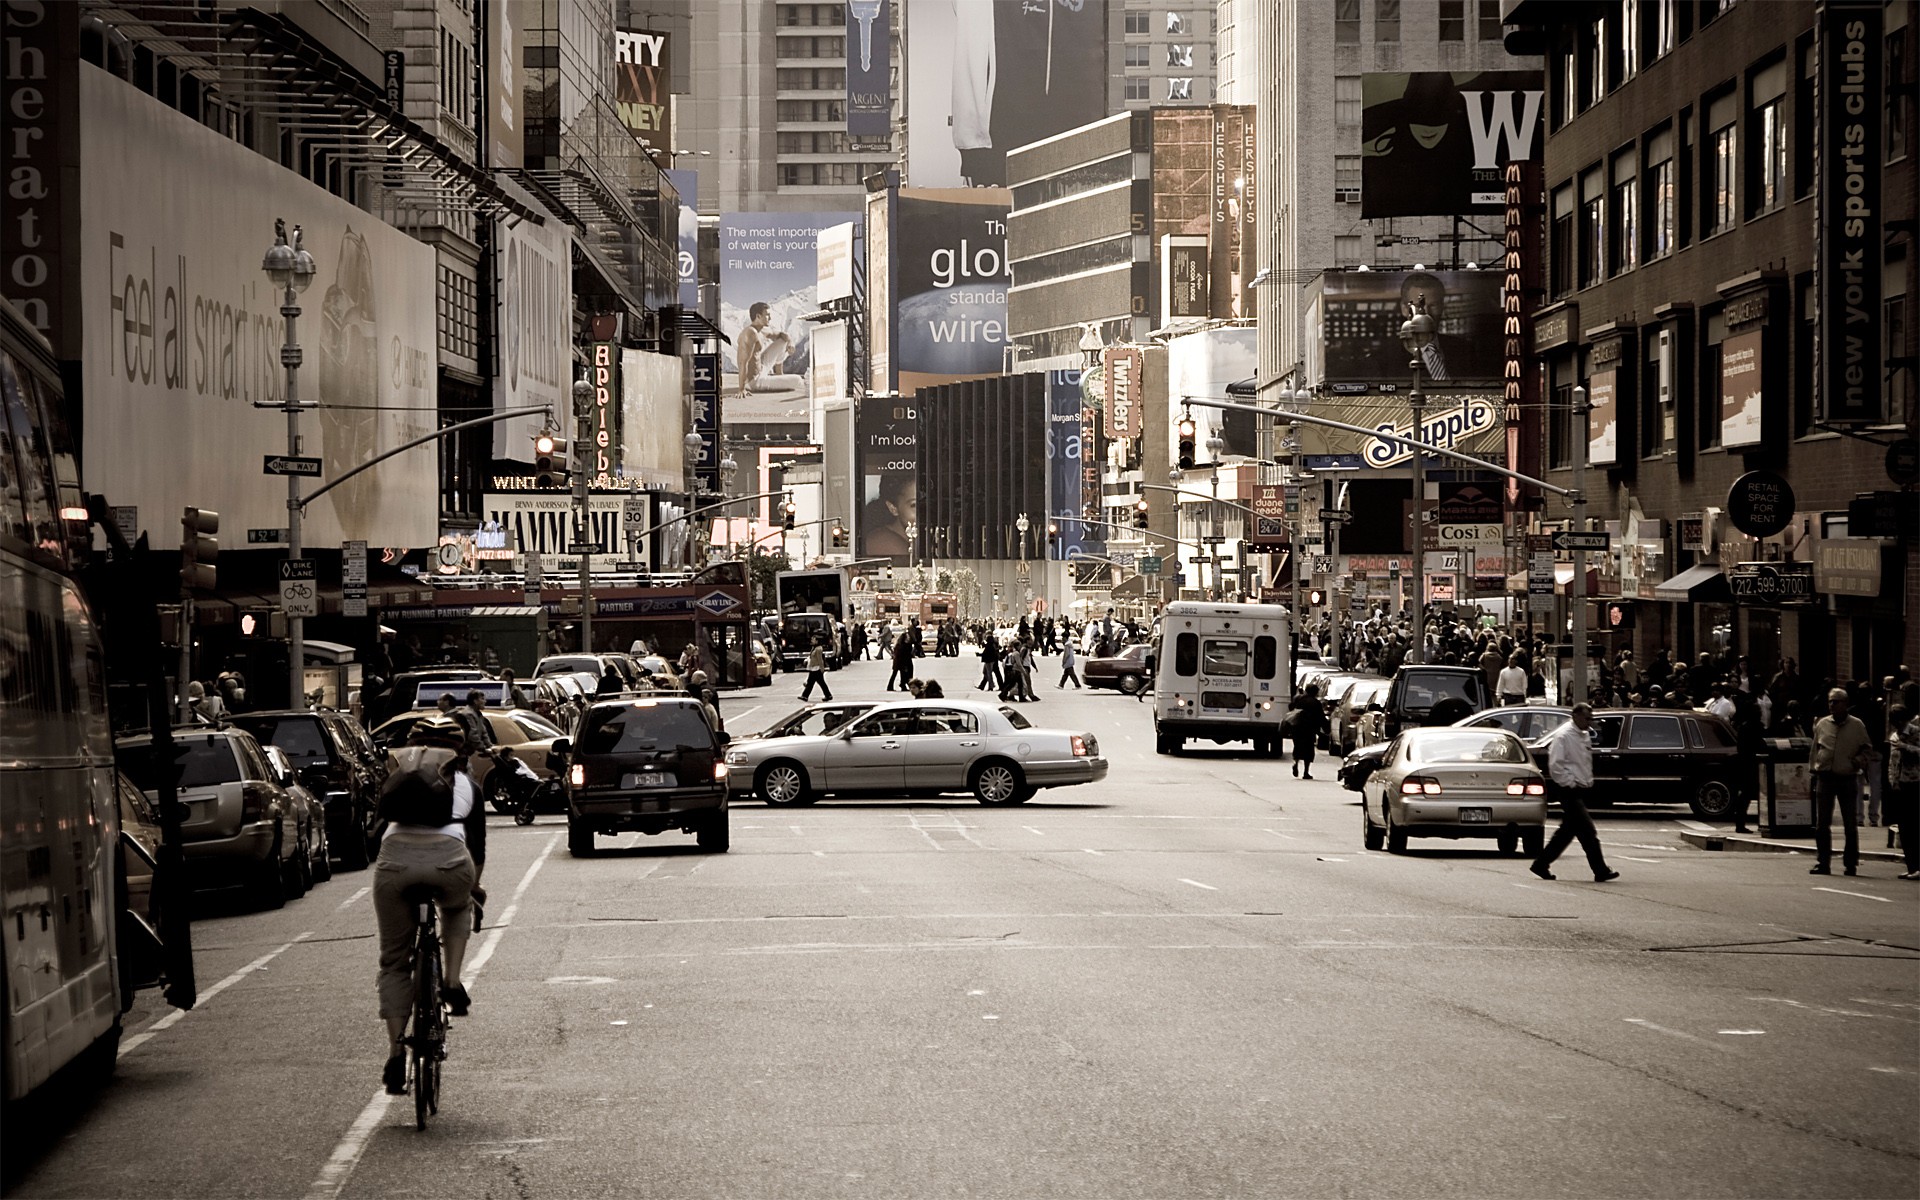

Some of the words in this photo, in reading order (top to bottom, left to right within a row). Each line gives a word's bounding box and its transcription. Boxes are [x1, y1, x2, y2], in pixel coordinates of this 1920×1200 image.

[1840, 20, 1865, 117] clubs
[1461, 91, 1544, 169] W
[1840, 124, 1871, 238] sports
[727, 227, 746, 237] The
[749, 228, 775, 237] most
[985, 220, 1007, 235] Th
[728, 240, 739, 250] of
[741, 241, 770, 250] water
[773, 240, 782, 250] is
[785, 242, 808, 252] your
[728, 259, 742, 269] Fill
[745, 259, 767, 269] with
[769, 261, 794, 269] care.
[1840, 247, 1869, 324] york
[950, 289, 1008, 304] standa
[110, 231, 156, 383] Feel
[164, 254, 188, 389] all
[194, 283, 249, 402] smart
[1845, 335, 1863, 408] new
[1113, 356, 1134, 432] Twizzlers
[1051, 414, 1074, 424] Morgan
[871, 435, 890, 445] I'm
[272, 461, 289, 470] ONE
[296, 462, 315, 471] WAY
[1748, 482, 1780, 492] RETAIL
[1255, 498, 1284, 507] duane
[1748, 493, 1780, 503] SPACE
[515, 501, 533, 509] BENNY
[535, 501, 568, 509] ANDERSSON
[1753, 503, 1774, 512] FOR
[1256, 507, 1283, 515] reade
[625, 512, 641, 522] 30
[1750, 514, 1776, 523] RENT
[1260, 525, 1279, 533] 24/7
[1441, 525, 1479, 540] Così
[249, 530, 256, 541] W
[258, 530, 268, 541] 52
[1560, 537, 1577, 545] ONE
[1584, 538, 1603, 546] WAY
[292, 561, 312, 569] BIKE
[291, 569, 314, 577] LANE
[1736, 576, 1803, 595] 212.599.3700
[288, 605, 308, 613] ONLY
[600, 602, 634, 612] PARTNER
[1180, 607, 1198, 615] 3862
[387, 611, 399, 620] MY
[402, 610, 435, 619] RUNNING
[437, 608, 471, 618] PARTNER
